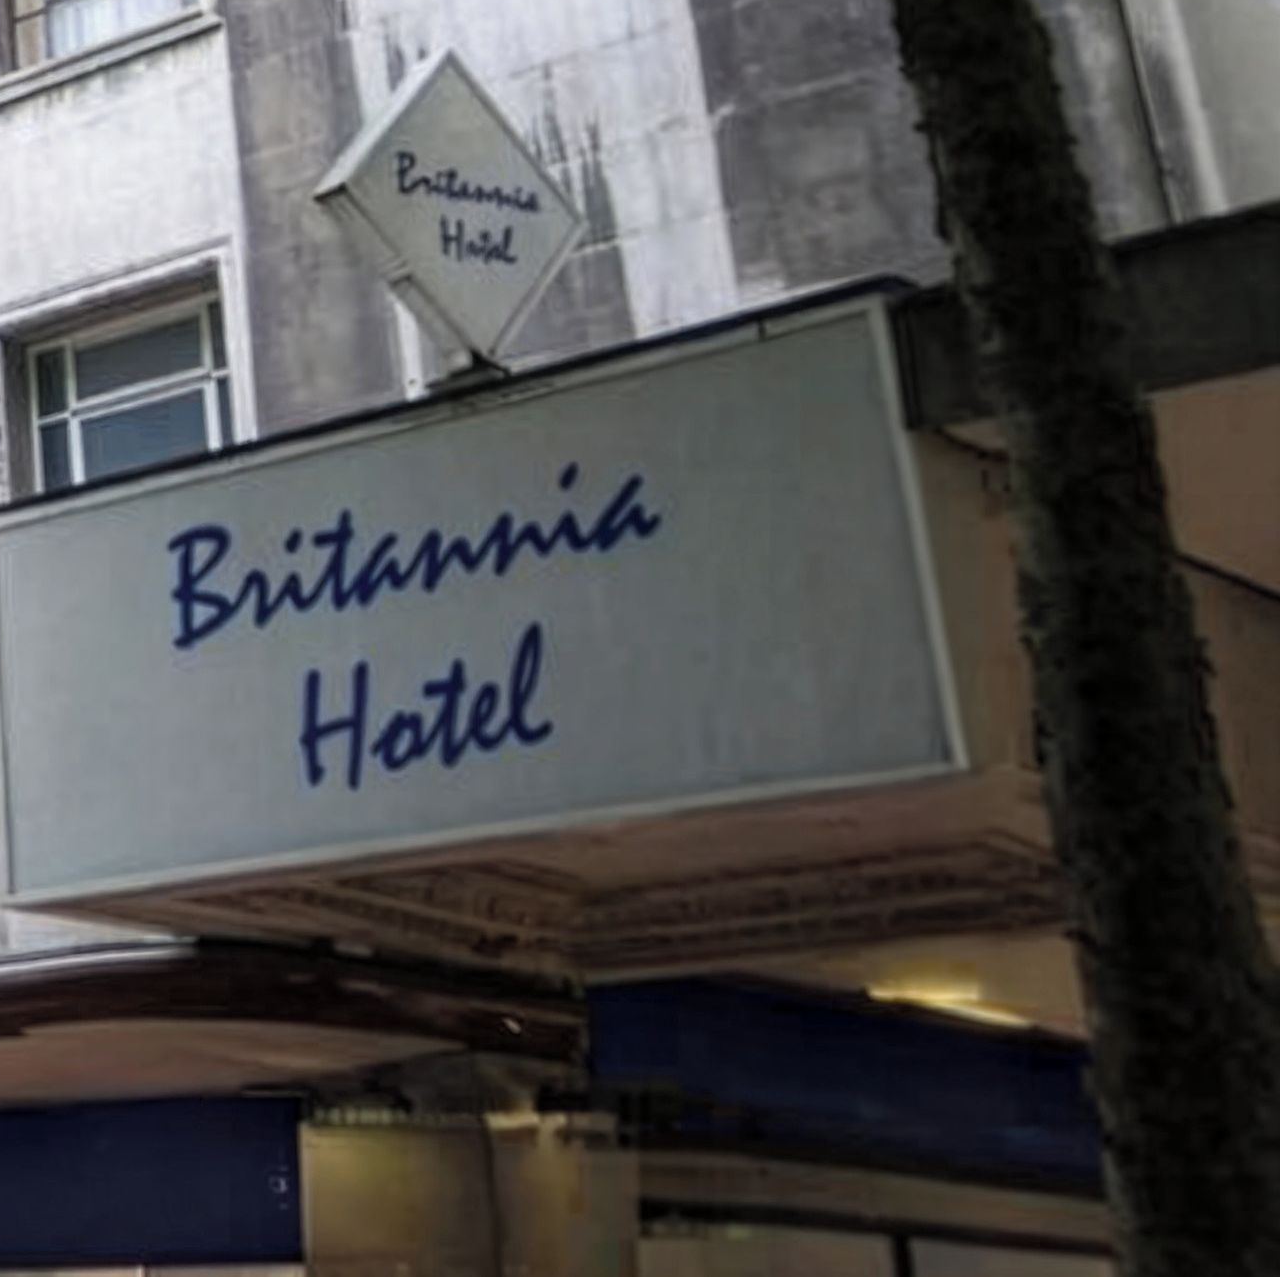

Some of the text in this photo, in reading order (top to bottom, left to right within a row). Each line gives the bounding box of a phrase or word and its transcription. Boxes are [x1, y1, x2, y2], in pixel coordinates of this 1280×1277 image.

[396, 150, 540, 212] Britannia
[440, 214, 517, 264] Hotel
[168, 461, 661, 649] Britannia
[298, 621, 553, 790] Hotel
